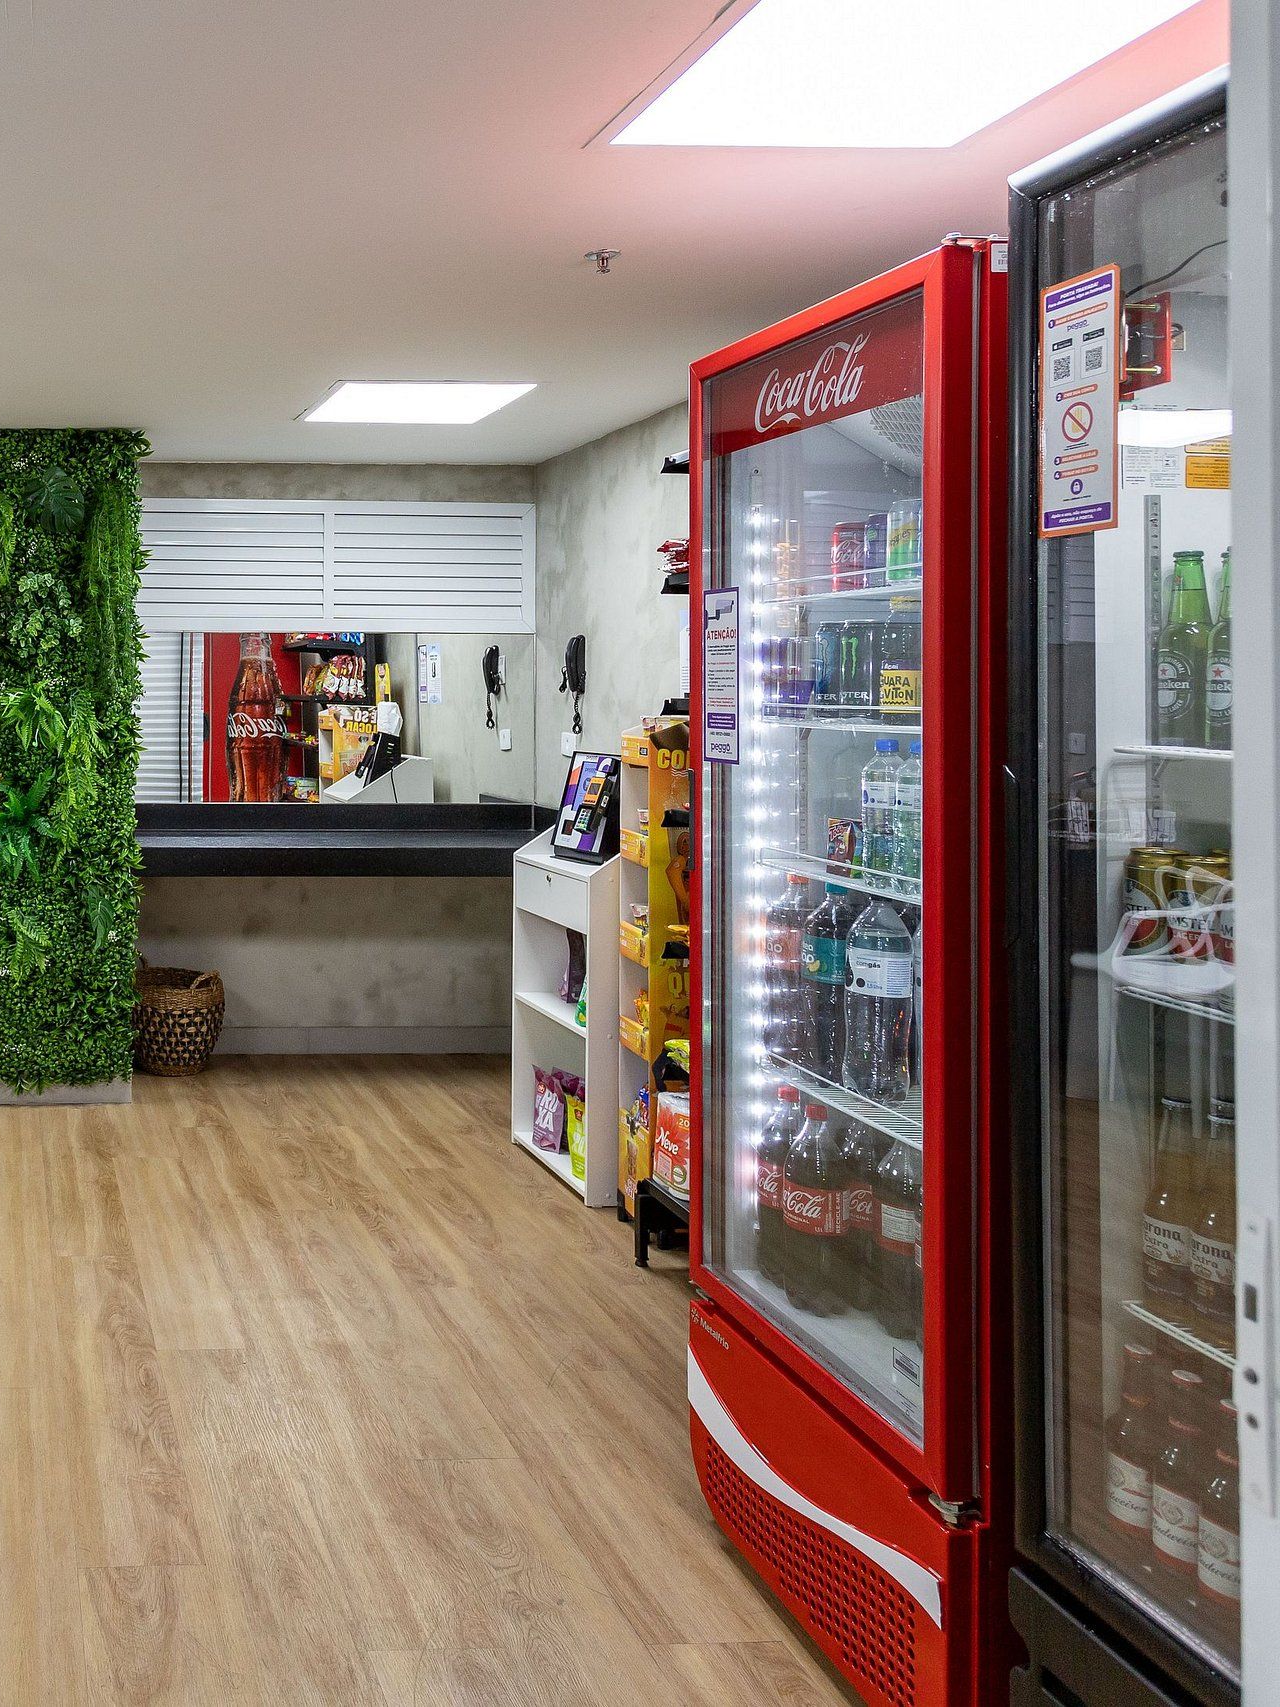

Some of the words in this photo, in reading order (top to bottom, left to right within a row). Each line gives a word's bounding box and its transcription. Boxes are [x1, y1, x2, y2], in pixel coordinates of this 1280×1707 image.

[755, 331, 870, 433] Coca-Cola
[707, 627, 736, 641] ATENÇÃO!
[657, 749, 685, 770] CO
[656, 1126, 679, 1155] Neve
